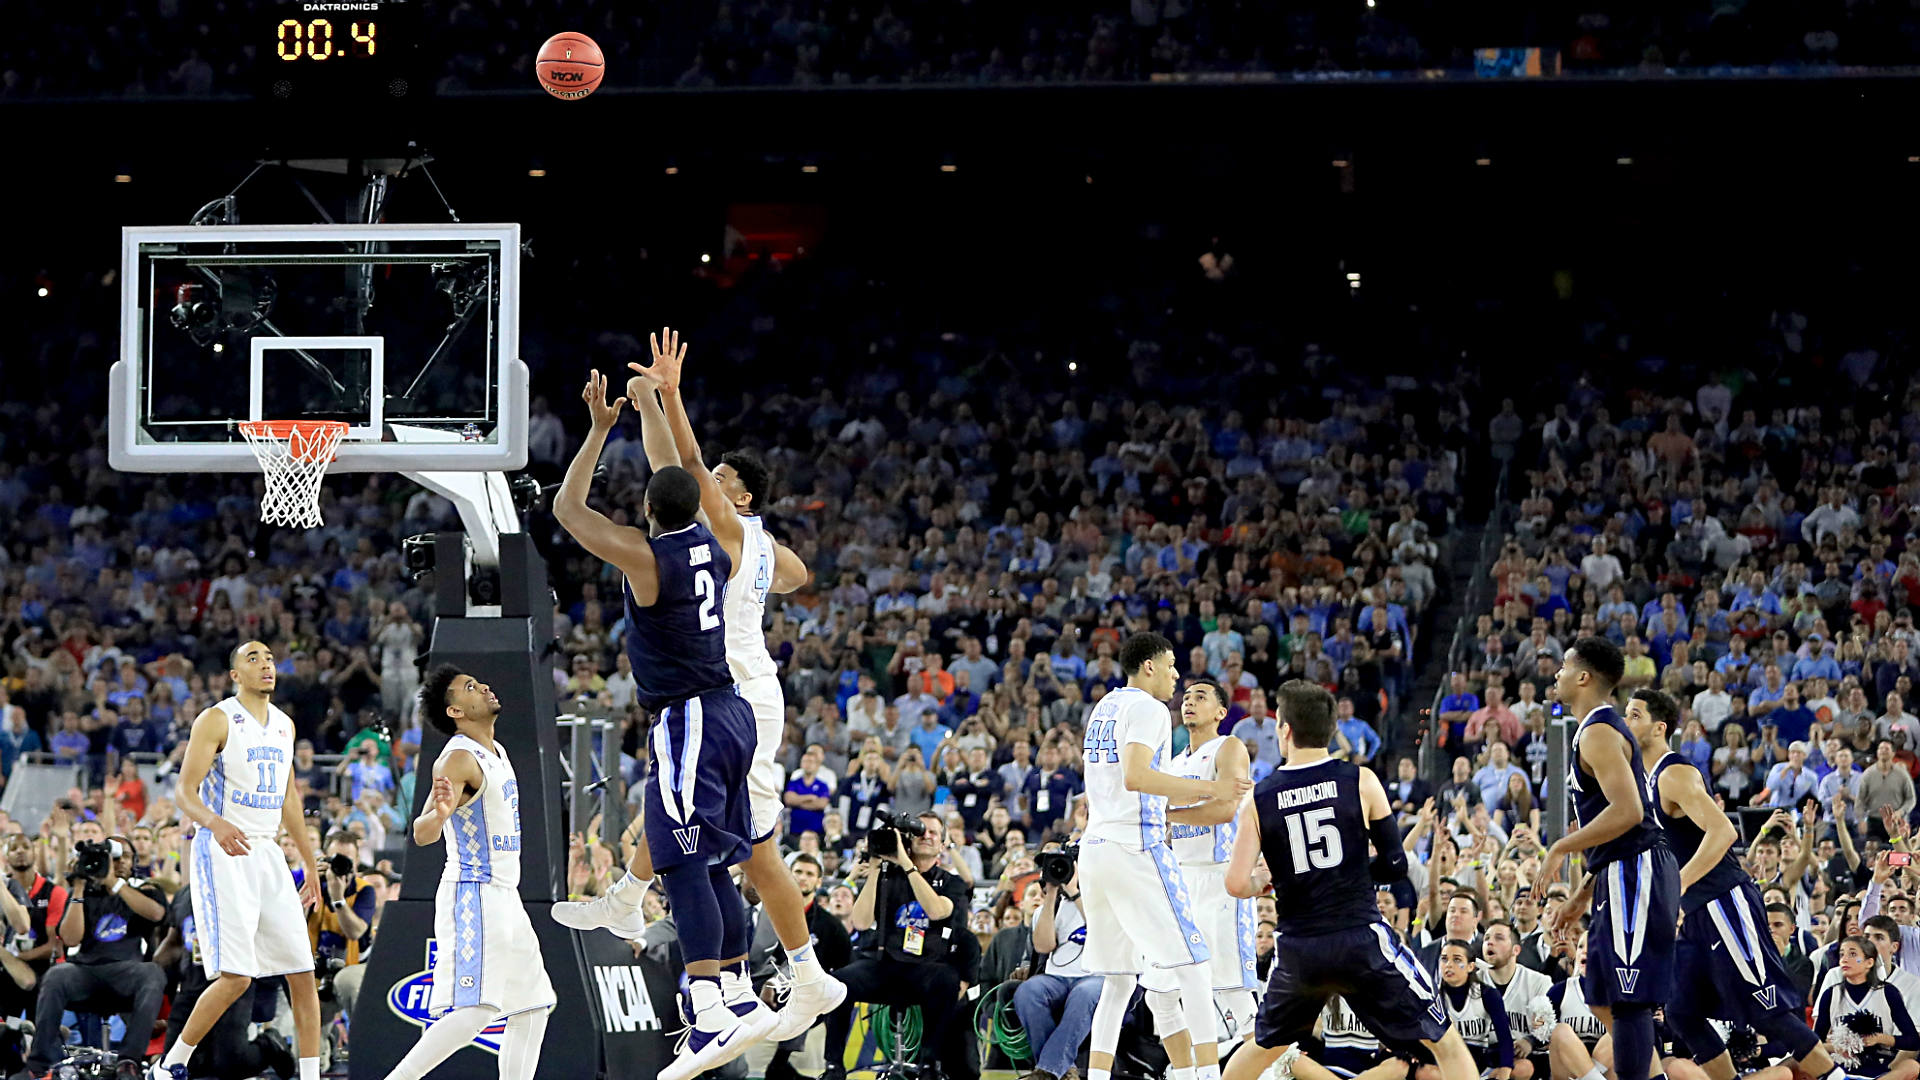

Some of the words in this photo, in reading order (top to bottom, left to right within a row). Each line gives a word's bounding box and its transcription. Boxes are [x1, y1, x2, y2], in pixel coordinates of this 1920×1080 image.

[304, 3, 378, 11] DAKTRONICS
[278, 19, 376, 60] 00.4
[551, 71, 584, 81] NCAA
[695, 570, 720, 631] 2
[1084, 720, 1119, 763] 44
[257, 763, 276, 793] 11
[1277, 781, 1338, 810] ARCIDIACONO
[1284, 807, 1343, 874] 15
[594, 966, 661, 1033] NCAA
